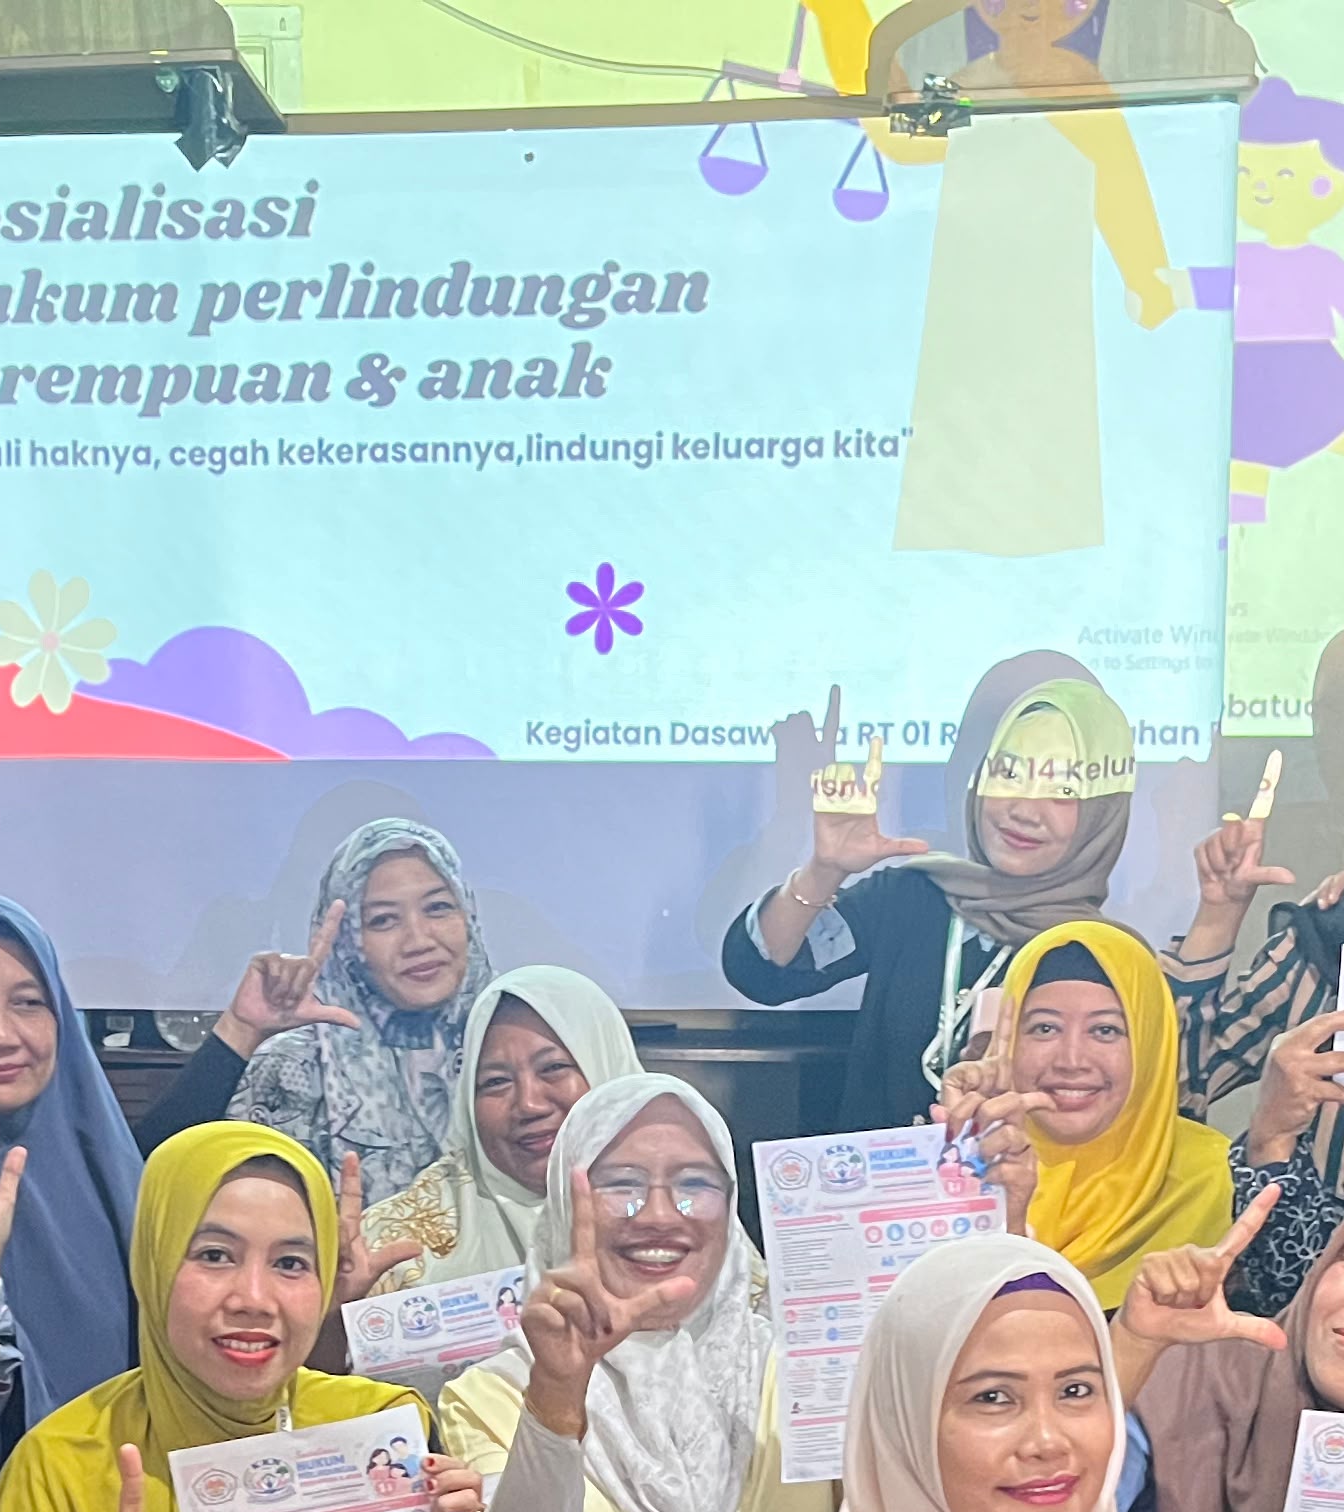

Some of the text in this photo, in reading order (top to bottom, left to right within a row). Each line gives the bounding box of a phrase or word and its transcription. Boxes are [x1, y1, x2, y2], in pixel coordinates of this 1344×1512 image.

[187, 260, 709, 337] perlindungan
[345, 352, 407, 408] &
[418, 341, 612, 400] anak
[30, 438, 160, 475] haknya,
[169, 438, 269, 475] cegah
[671, 431, 824, 469] keluarga
[526, 719, 661, 752] Kegiatan
[859, 722, 895, 746] RT
[902, 721, 930, 746] 01
